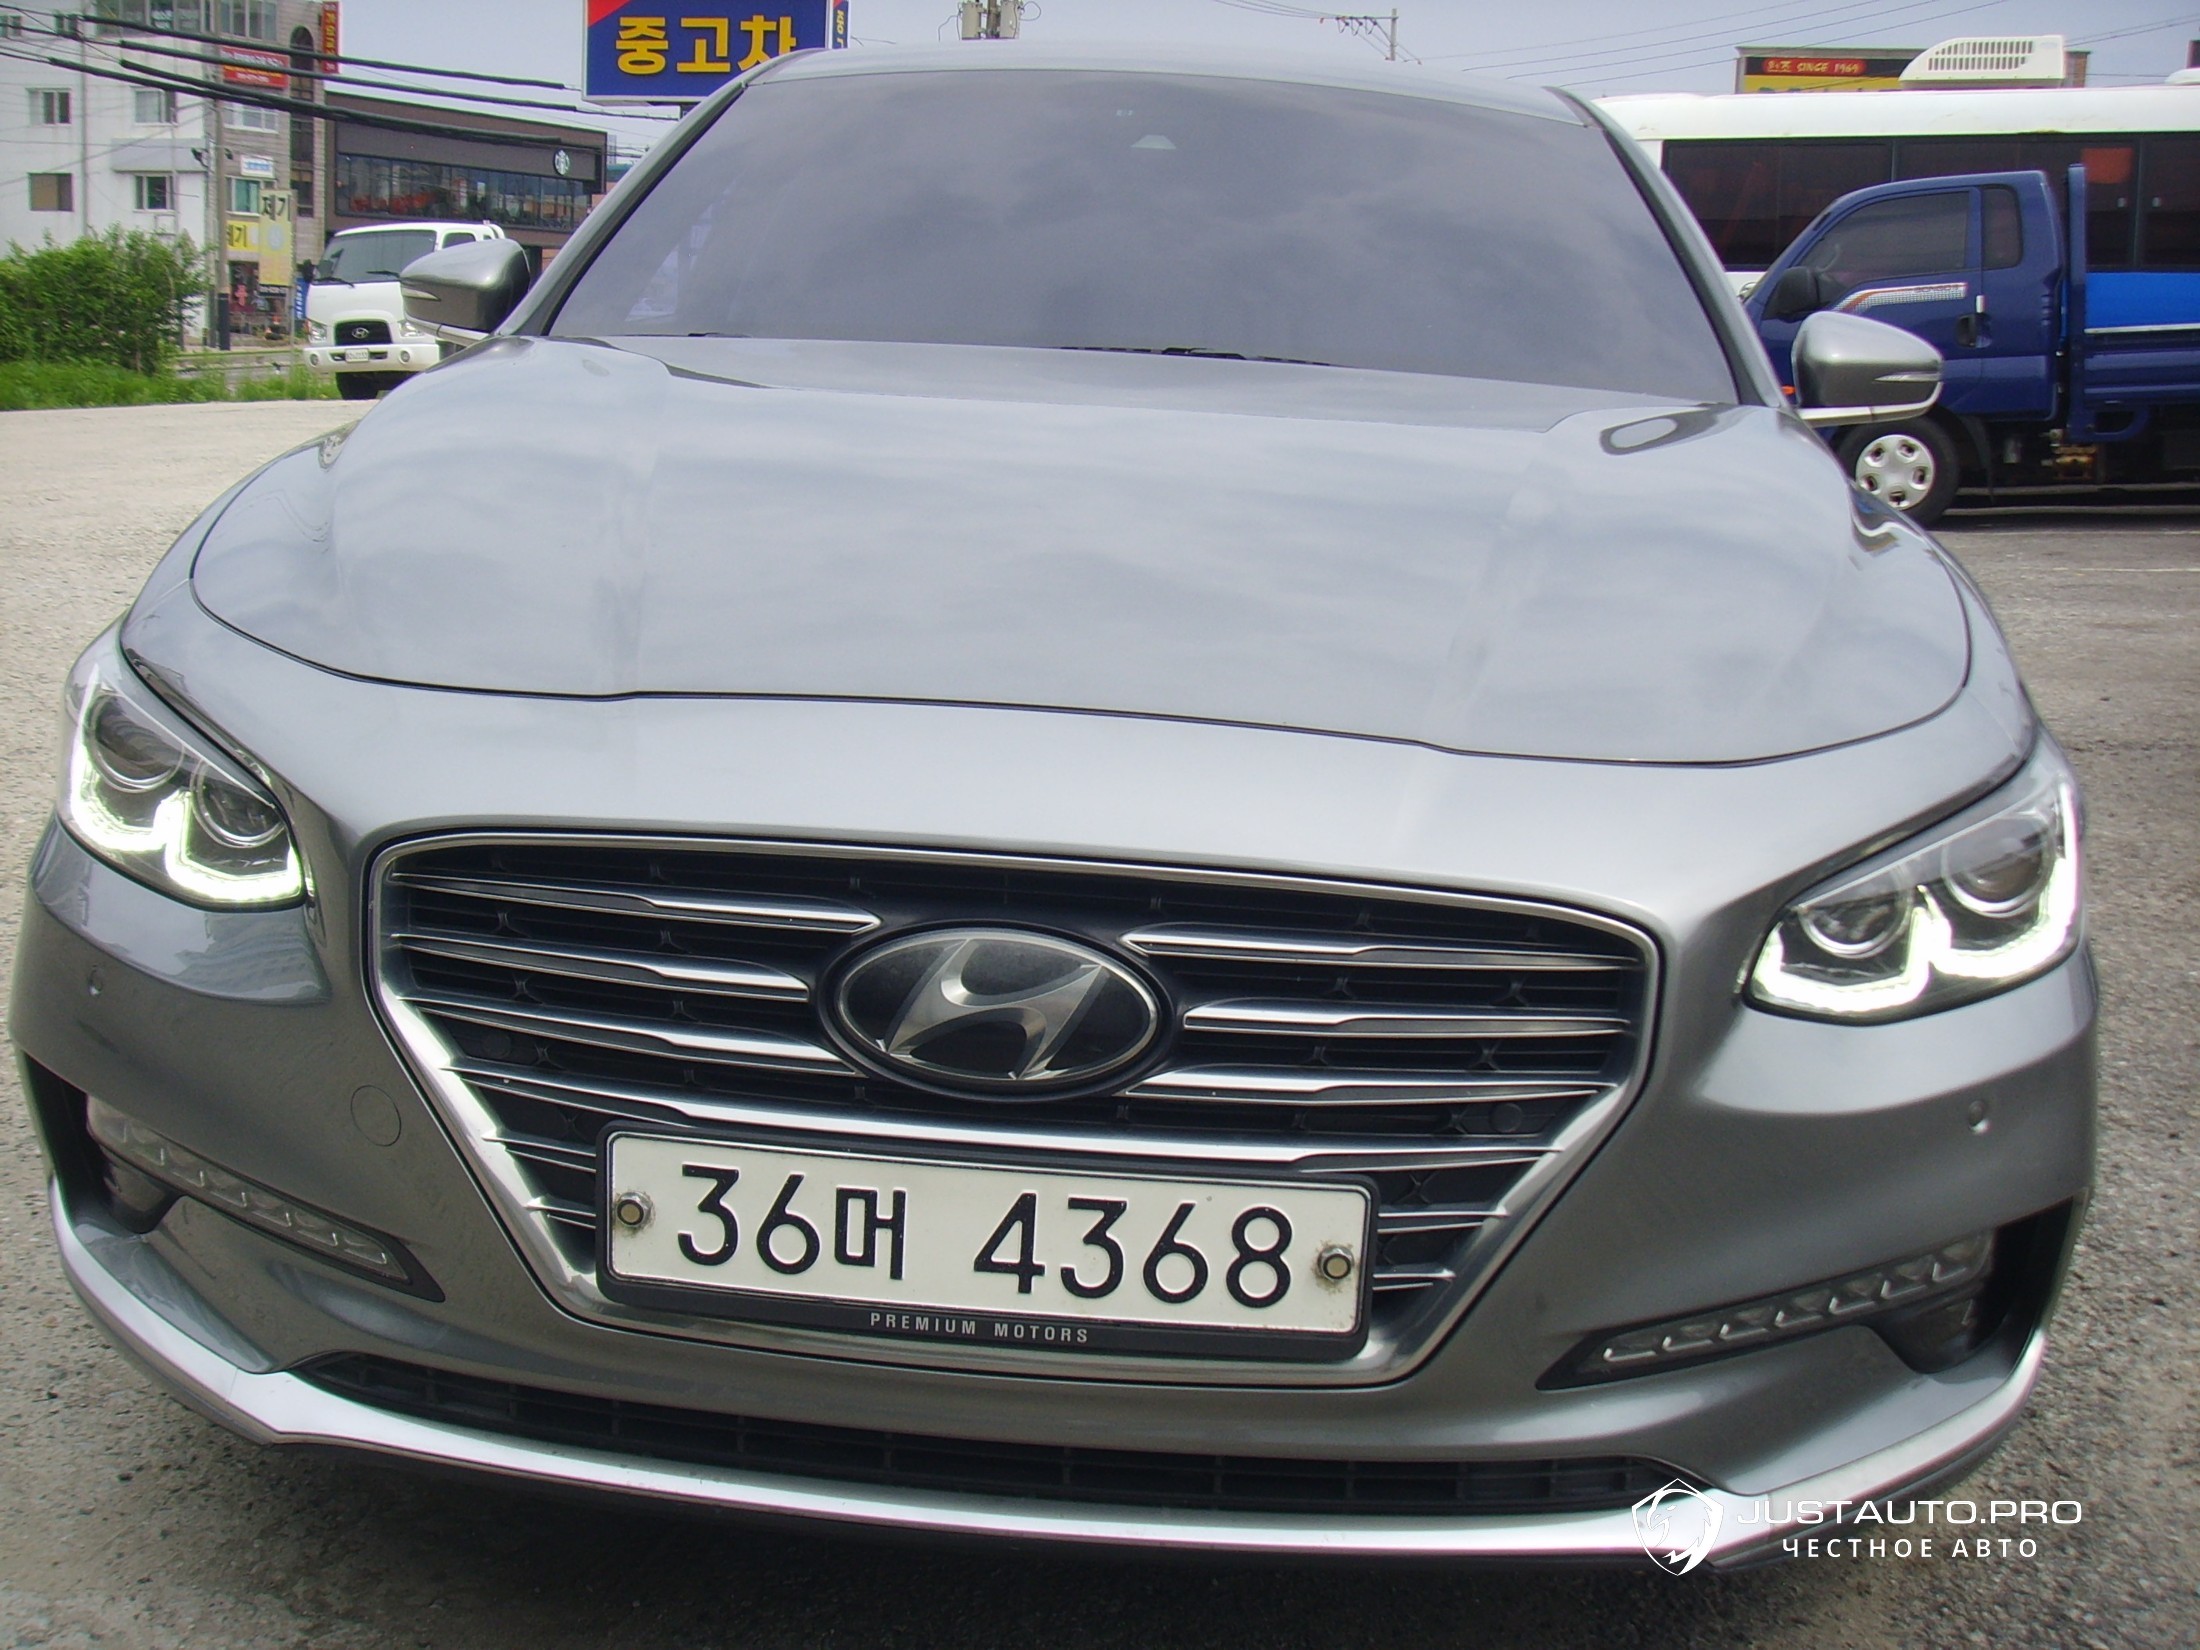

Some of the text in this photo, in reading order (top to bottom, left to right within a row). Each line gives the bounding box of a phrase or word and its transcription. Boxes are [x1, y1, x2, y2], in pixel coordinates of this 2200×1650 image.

[616, 15, 797, 75] 중고차
[1834, 62, 1859, 74] 1969
[677, 1163, 1293, 1309] 36머 4368
[870, 1312, 1089, 1344] PREMIUM MOTORS
